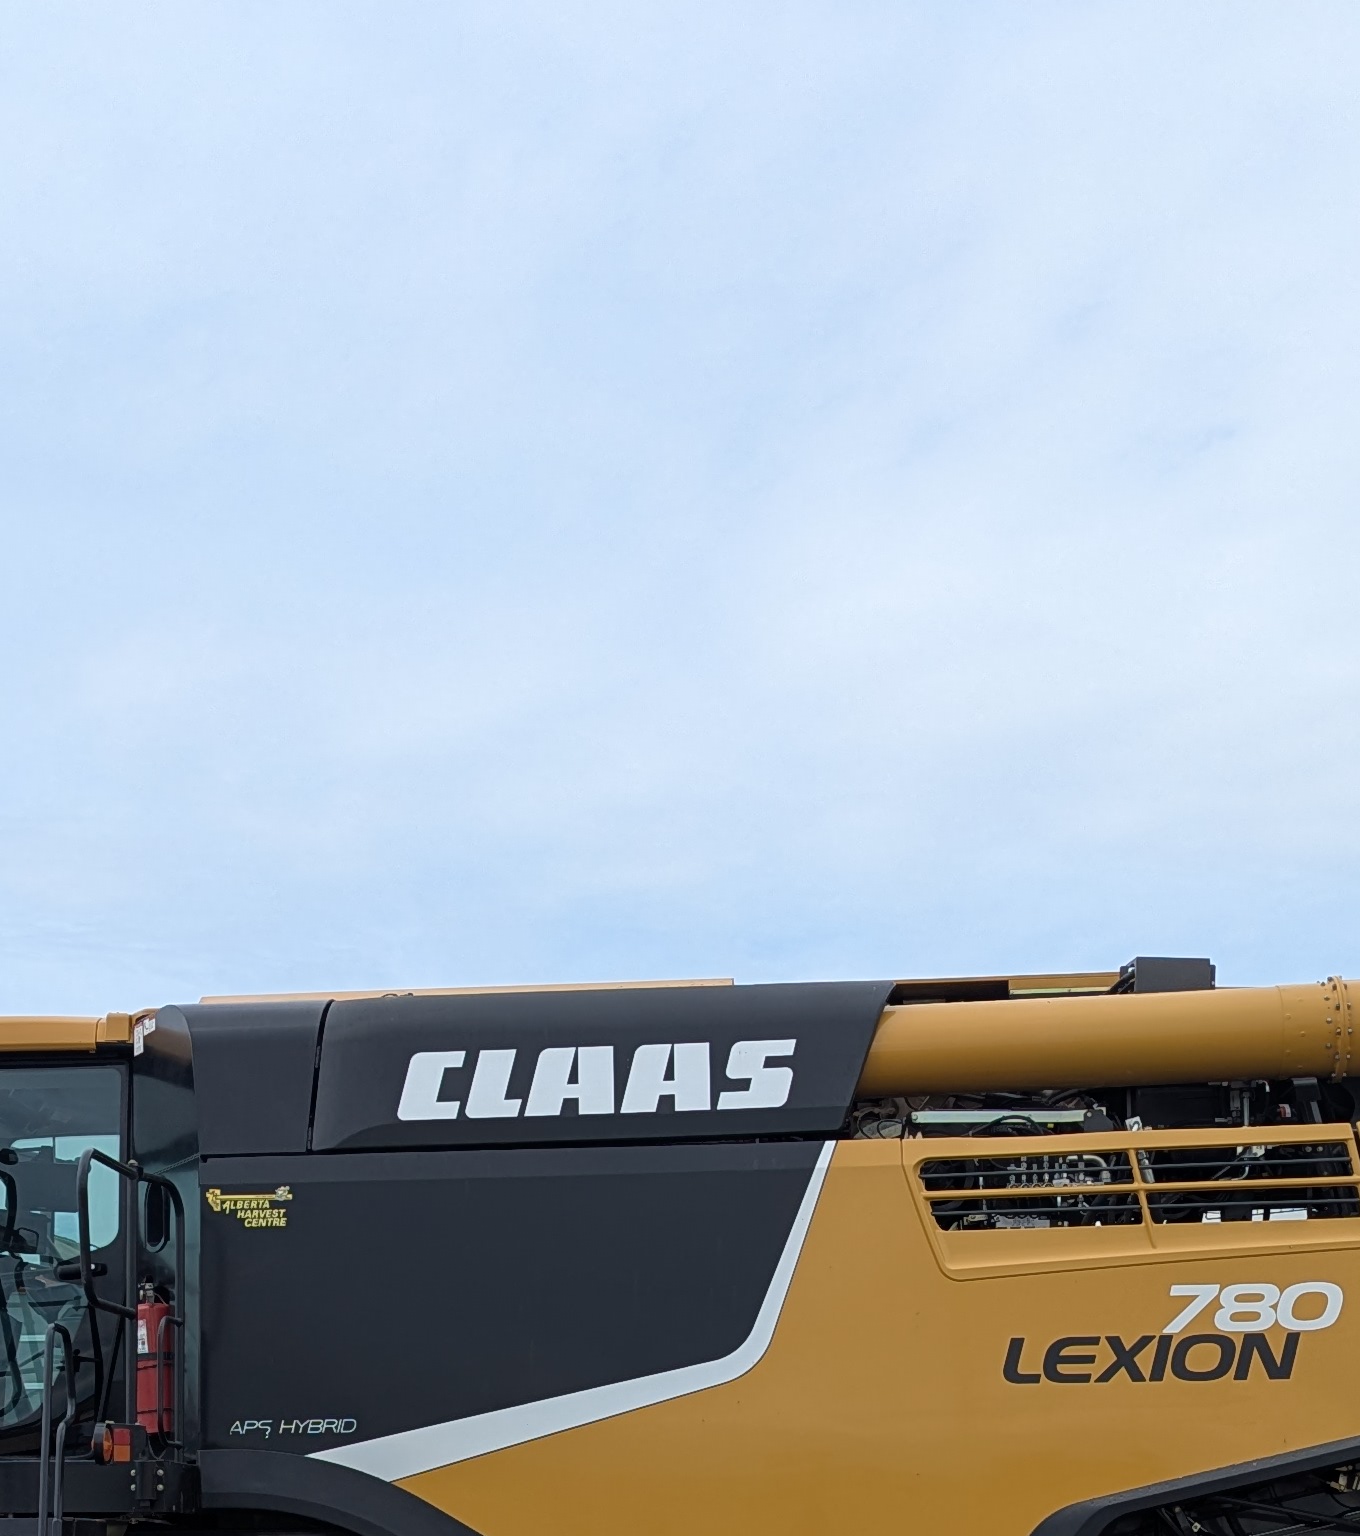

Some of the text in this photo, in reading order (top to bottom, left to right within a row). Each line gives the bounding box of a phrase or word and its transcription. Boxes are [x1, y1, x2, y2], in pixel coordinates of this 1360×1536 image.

[396, 1038, 797, 1121] CLAAS
[222, 1200, 270, 1215] ALBERTA
[237, 1209, 287, 1219] HARVEST
[244, 1217, 288, 1228] CENTRE
[1162, 1281, 1344, 1333] 780
[1002, 1333, 1301, 1384] LEXION
[229, 1418, 358, 1439] APS HYBRID
